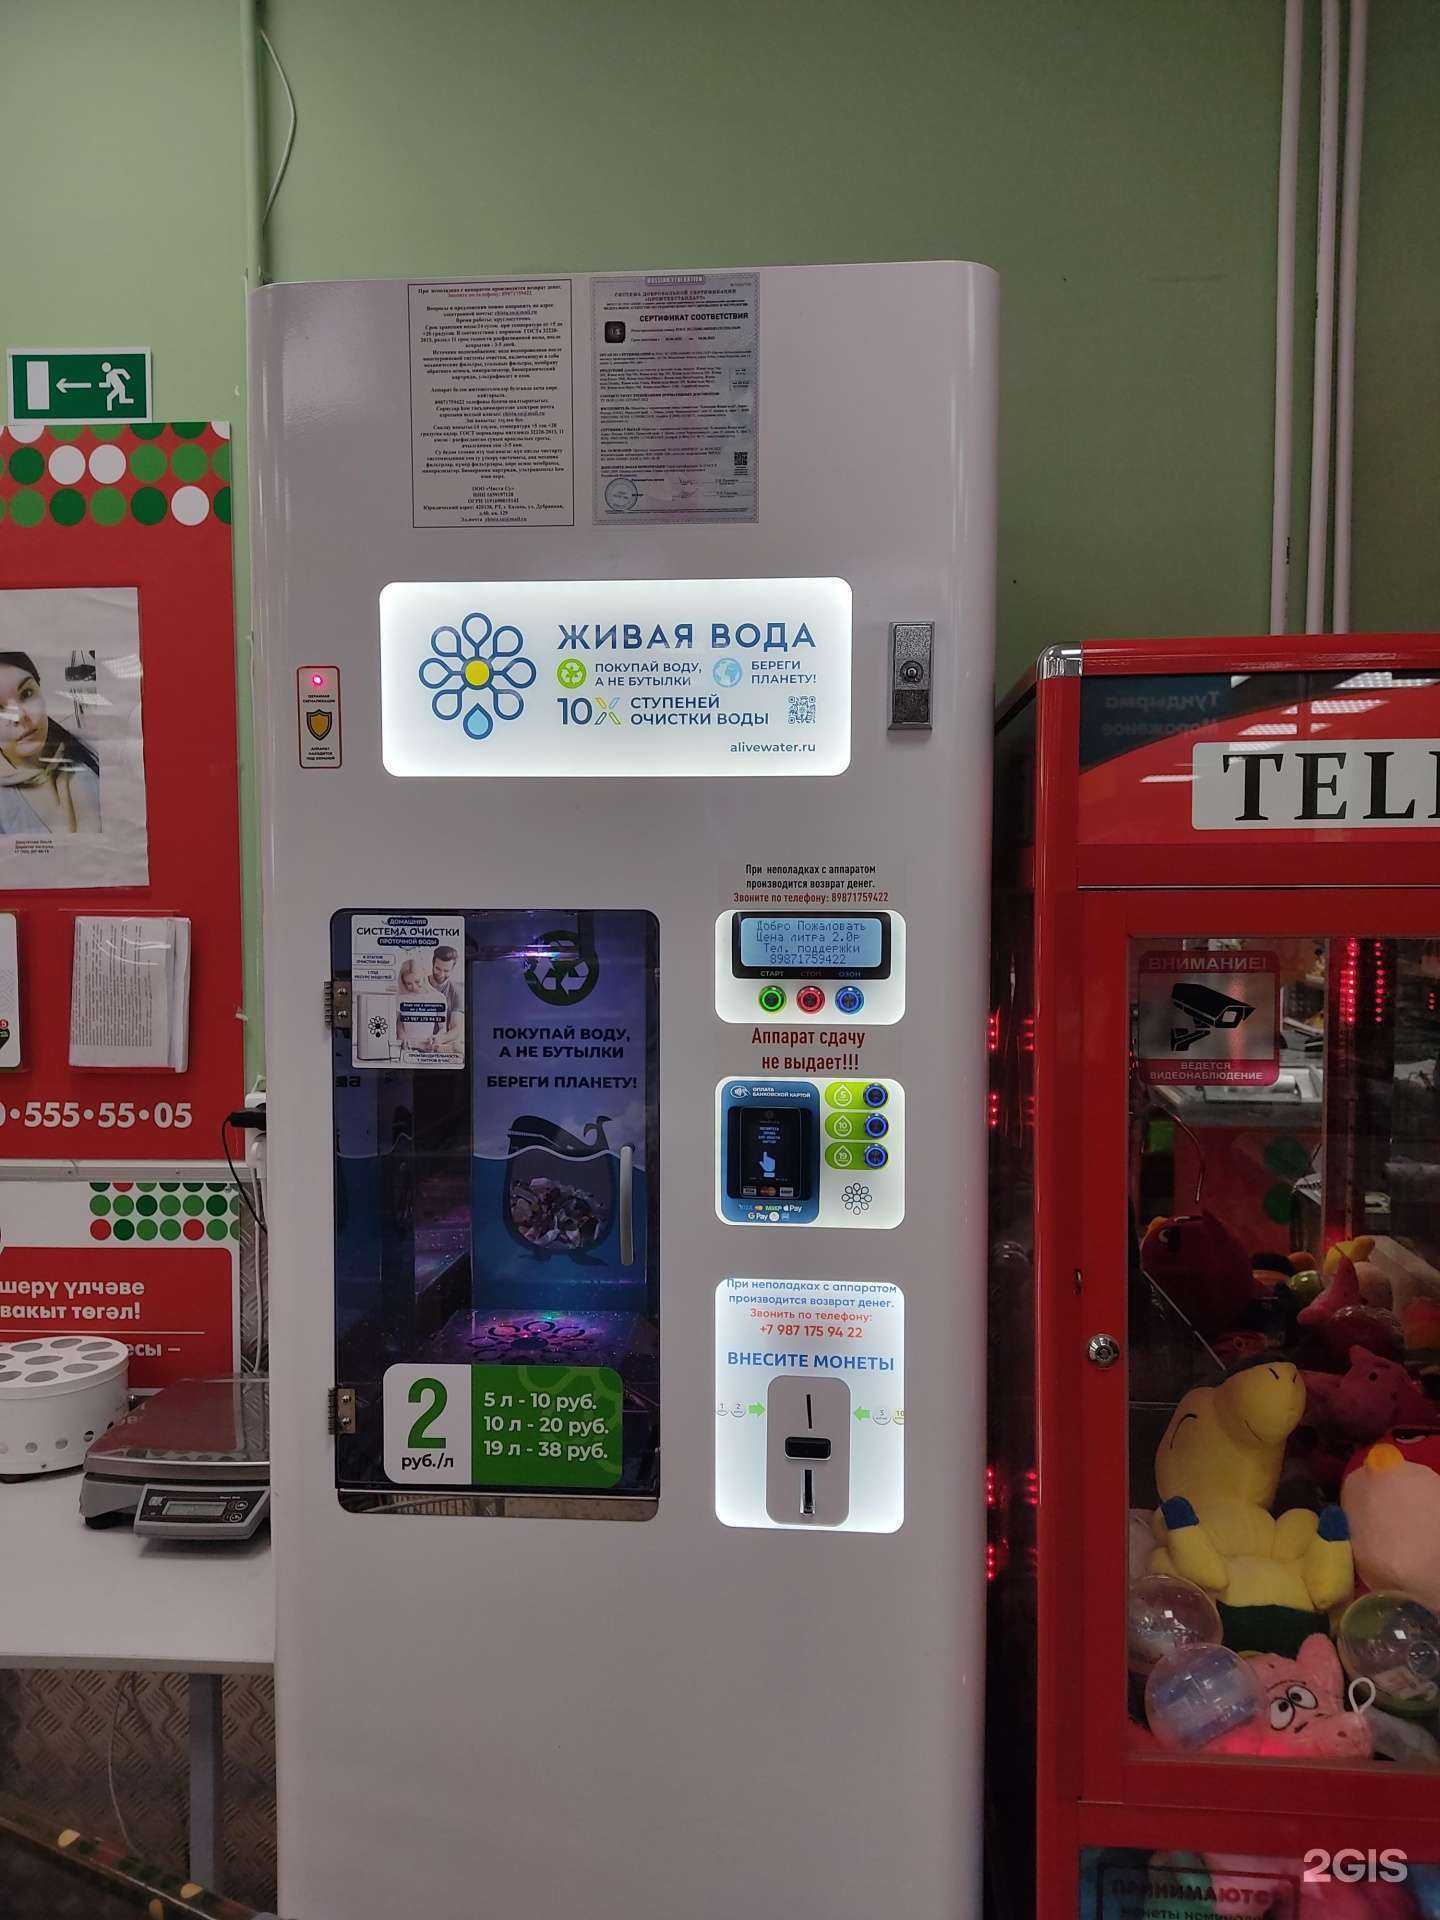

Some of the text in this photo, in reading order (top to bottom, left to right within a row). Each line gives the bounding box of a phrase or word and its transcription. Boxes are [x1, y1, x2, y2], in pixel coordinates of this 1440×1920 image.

[639, 312, 749, 323] СЕРТИФИКАТ СООТВЕТСТВИЯ
[557, 622, 816, 651] ЖИВАЯ ВОДА
[595, 660, 702, 675] ПОКУПАЙ ВОДУ,
[751, 660, 801, 671] БЕРЕГИ
[595, 676, 691, 687] А НЕ БУТЫЛКИ
[751, 673, 817, 685] ПЛАНЕТУ!
[630, 693, 720, 710] СТУПЕНЕЙ
[630, 712, 769, 726] ОЧИСТКИ ВОДЫ
[730, 741, 816, 753] alivewater.ru
[1222, 750, 1440, 821] TEL
[745, 864, 762, 876] При
[767, 864, 820, 875] неполадках
[828, 864, 876, 875] аппаратом
[746, 879, 875, 890] производится возврат денег.
[733, 892, 889, 904] Звоните по телефону: 89871759422
[356, 927, 460, 937] СИСТЕМА ОЧИСТКИ
[756, 920, 866, 931] Добро Пожаловать
[379, 937, 437, 946] ПРОТОЧНОЙ ВОДЫ
[756, 932, 784, 942] Цена
[790, 933, 825, 942] литра
[764, 943, 860, 954] Тел. поддержки
[770, 954, 846, 964] 89871759422
[1149, 956, 1267, 971] ВНИМАНИЕ!
[493, 1025, 631, 1042] ПОКУПАЙ ВОДУ,
[752, 1027, 865, 1049] Аппарат сдачу
[499, 1046, 624, 1058] А НЕ БУТЫЛКИ
[762, 1053, 859, 1072] не выдает!!!
[1180, 1061, 1231, 1071] ВЕДЕТСЯ
[487, 1076, 637, 1089] БЕРЕГИ ПЛАНЕТУ!
[1150, 1071, 1263, 1081] ВИДЕОНАБЛЮДЕНИЕ
[789, 1205, 803, 1213] Pay
[756, 1213, 769, 1222] Pay
[63, 1280, 145, 1299] үлчәве
[727, 1278, 749, 1292] При
[752, 1281, 820, 1293] неполадках
[832, 1283, 897, 1295] аппаратом
[729, 1295, 895, 1310] производится возврат денег.
[72, 1302, 141, 1320] төгәл!
[750, 1308, 873, 1324] Звонить по телефону:
[760, 1325, 863, 1338] +7 987 175 94 22
[728, 1351, 895, 1372] ВНЕСИТЕ МОНЕТЫ
[483, 1393, 496, 1407] 5
[499, 1395, 513, 1407] л
[530, 1393, 551, 1408] 10
[556, 1393, 597, 1413] руб.
[407, 1377, 448, 1449] 2
[483, 1417, 505, 1431] 10
[508, 1419, 521, 1431] л
[539, 1418, 563, 1433] 20
[568, 1417, 609, 1438] руб.
[483, 1441, 504, 1455] 19
[507, 1442, 521, 1456] л
[538, 1441, 562, 1457] 38
[567, 1442, 608, 1462] руб.
[401, 1453, 454, 1471] руб./л
